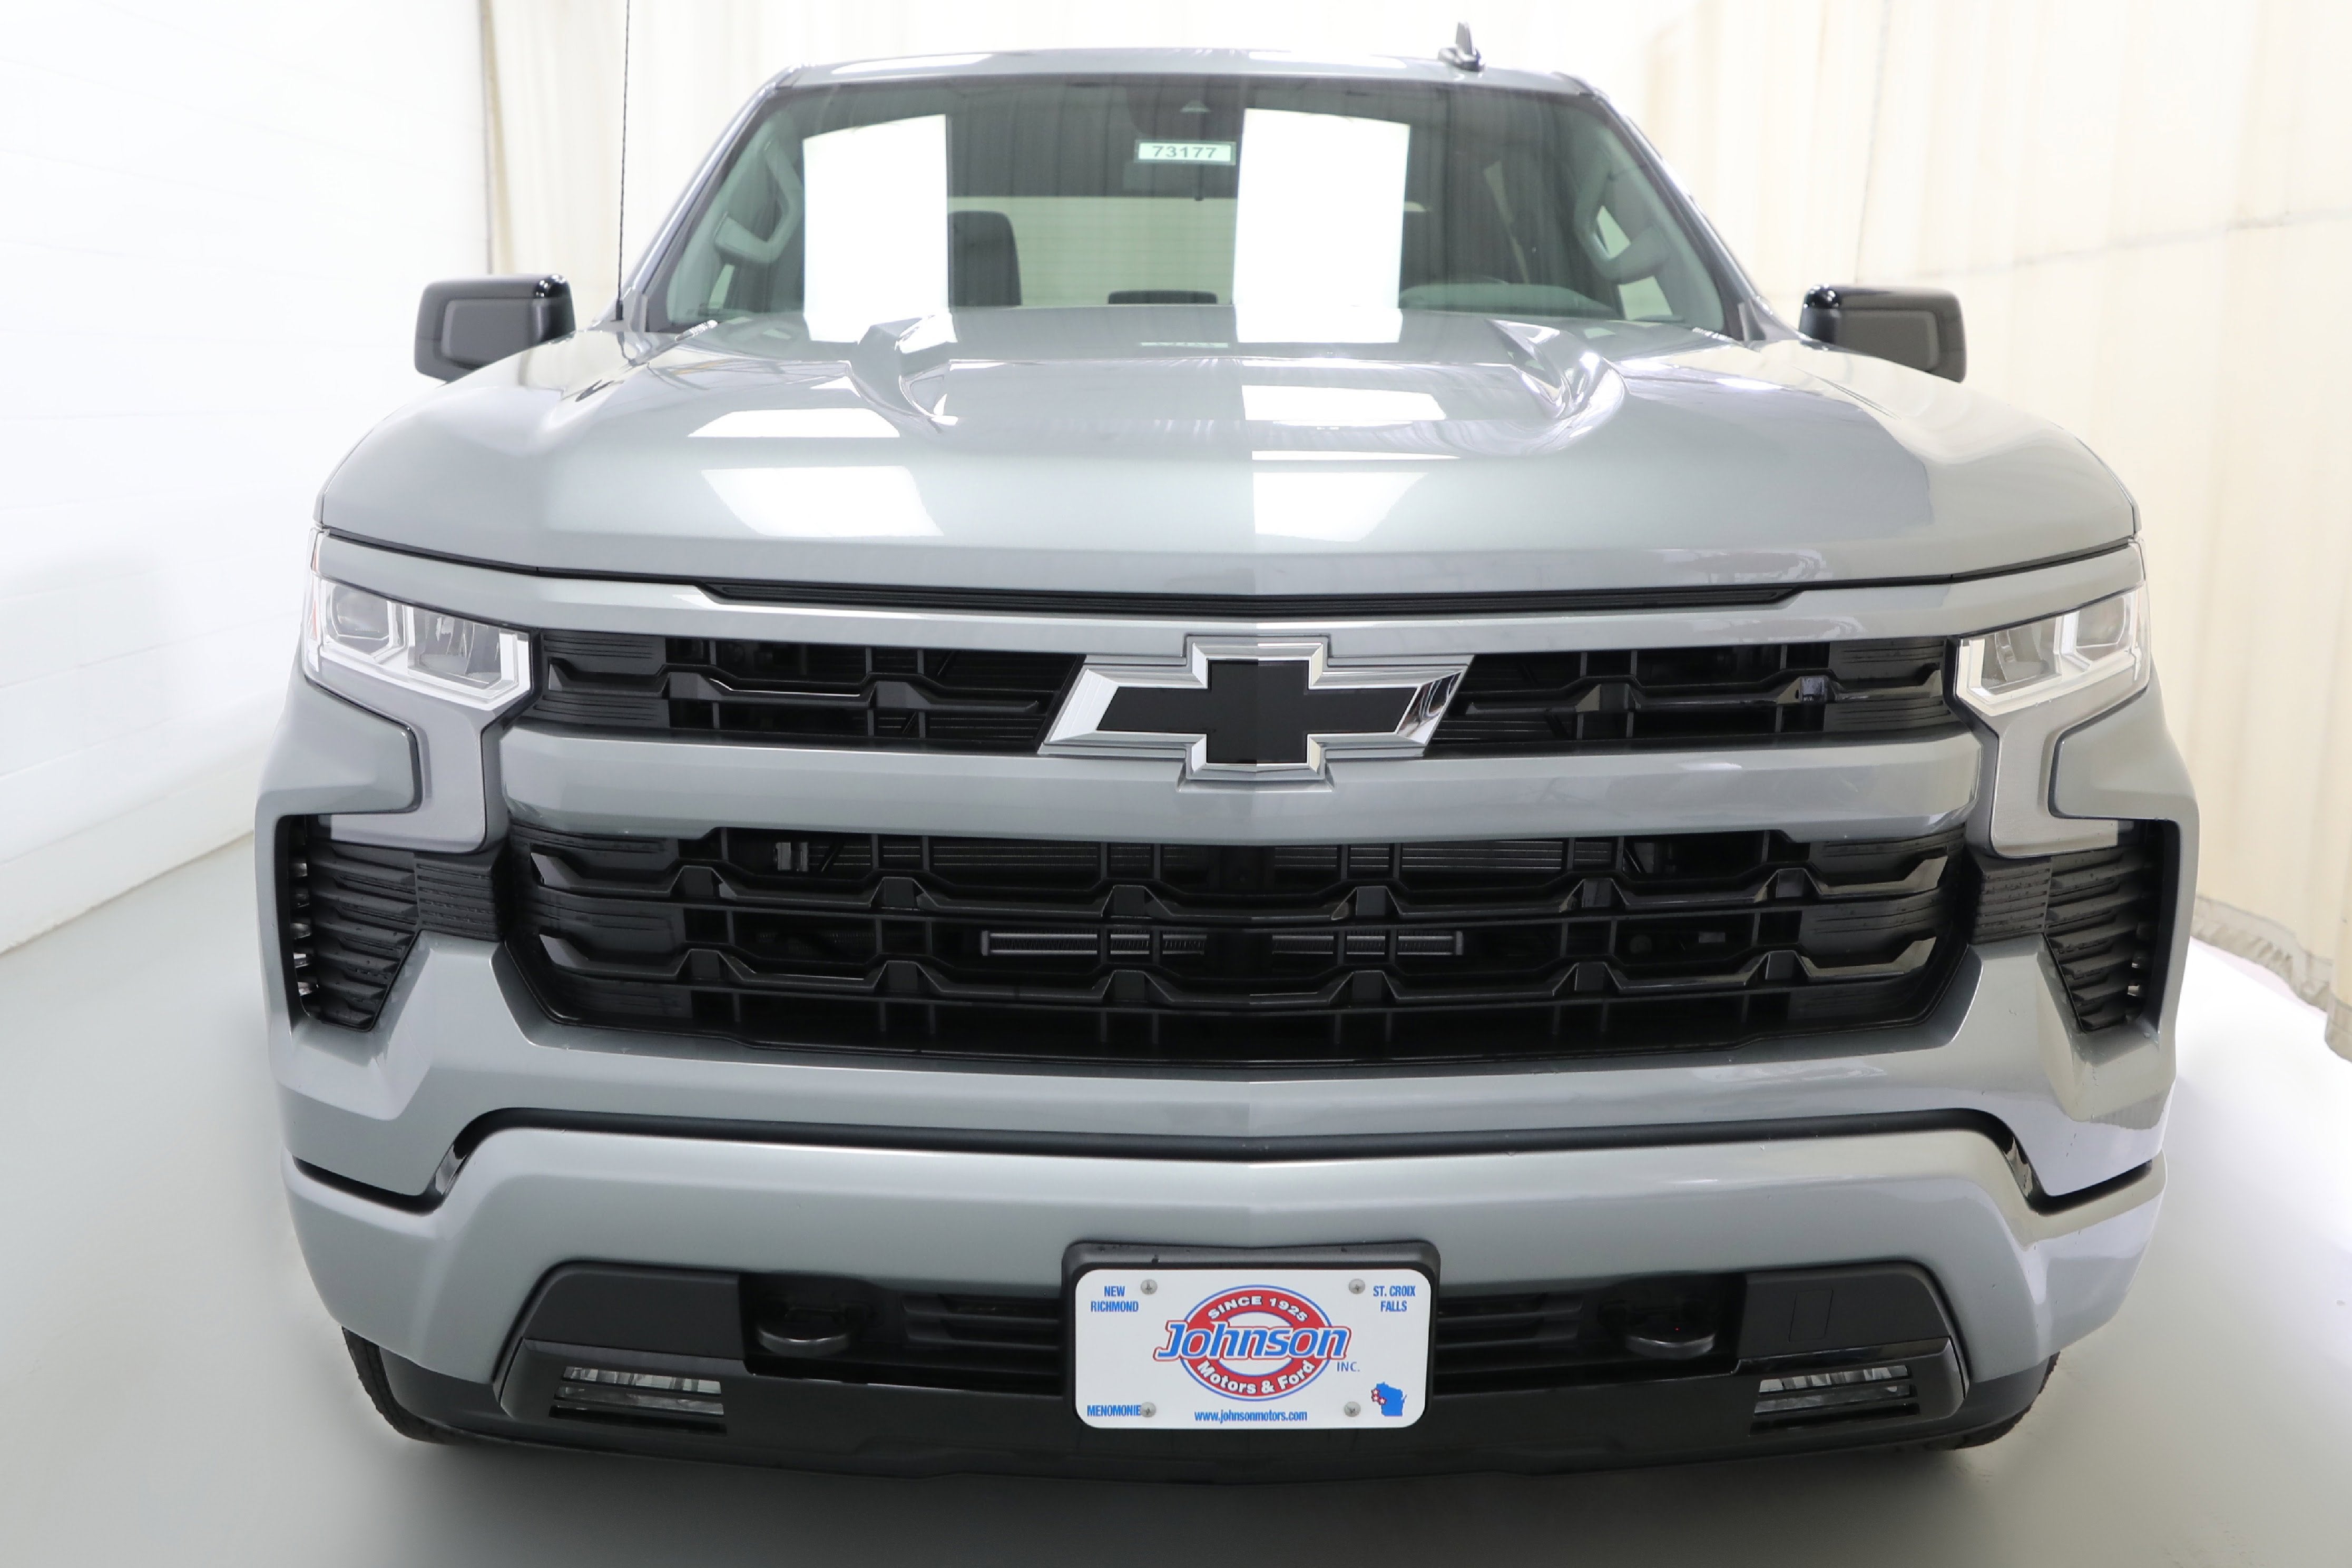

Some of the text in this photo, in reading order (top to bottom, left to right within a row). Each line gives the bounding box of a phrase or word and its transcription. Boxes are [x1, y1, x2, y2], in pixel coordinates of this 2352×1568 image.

[1152, 145, 1217, 158] 73177
[1104, 1286, 1125, 1297] NEW
[1373, 1285, 1416, 1297] ST. CROIX
[1090, 1301, 1139, 1312] RICHMOND
[1208, 1296, 1309, 1322] SINCE 1925
[1380, 1300, 1407, 1312] FALLS
[1157, 1321, 1349, 1359] Johnson
[1336, 1361, 1360, 1372] INC.
[1197, 1359, 1316, 1394] Motors & Ford
[1087, 1405, 1141, 1416] MENOMONIE
[1194, 1409, 1308, 1424] www.johnsonmotors.com
